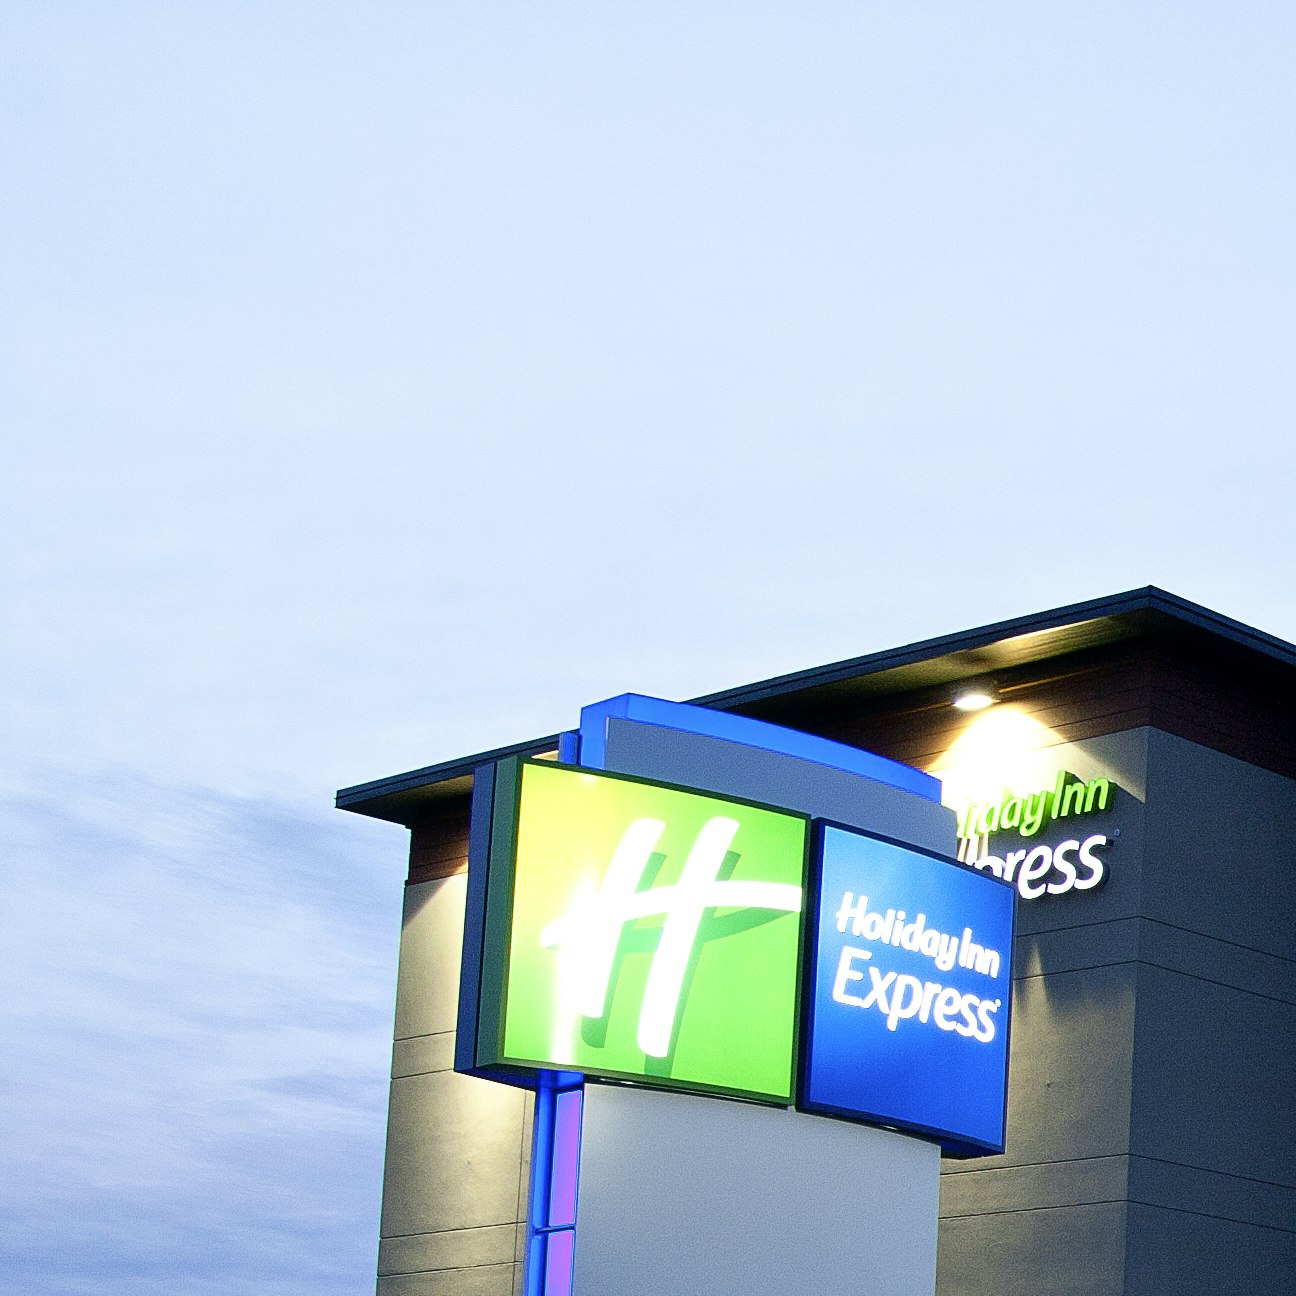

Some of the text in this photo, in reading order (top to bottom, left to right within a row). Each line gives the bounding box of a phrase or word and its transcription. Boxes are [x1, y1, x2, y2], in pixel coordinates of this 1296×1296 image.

[957, 770, 1109, 838] liday Inn
[836, 891, 1001, 978] Holiday Inn
[832, 945, 999, 1043] Express
